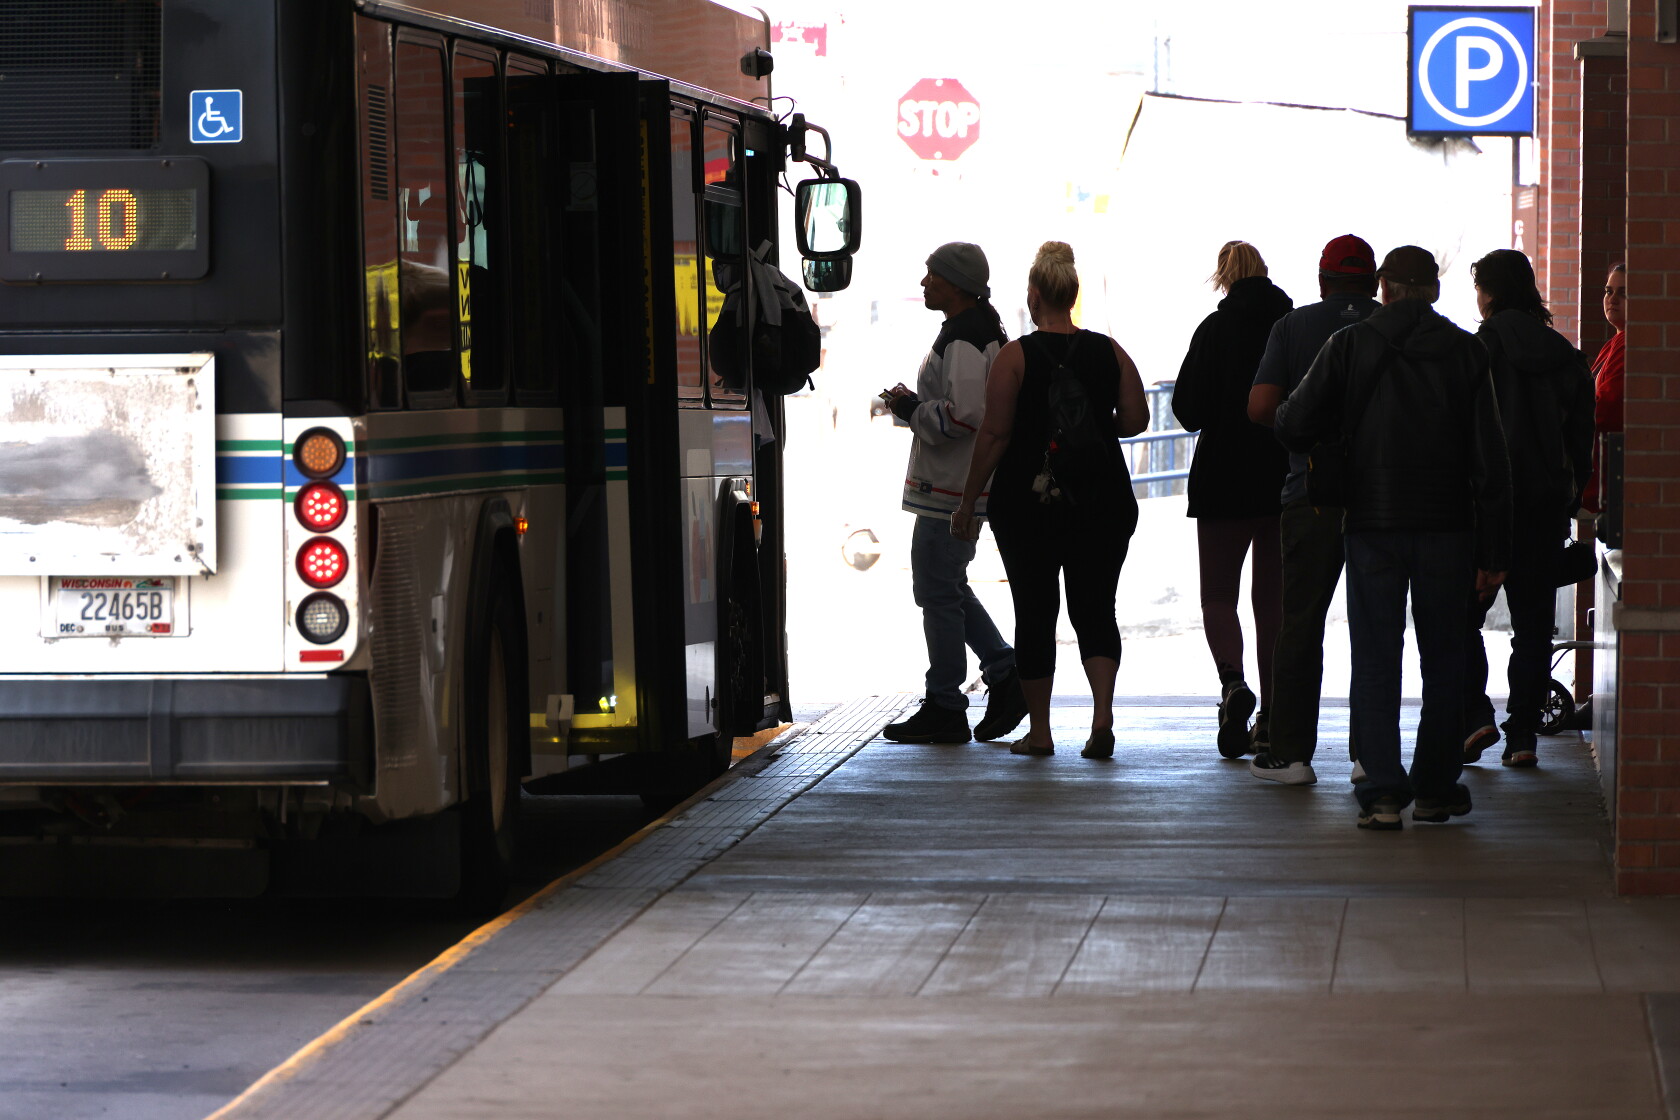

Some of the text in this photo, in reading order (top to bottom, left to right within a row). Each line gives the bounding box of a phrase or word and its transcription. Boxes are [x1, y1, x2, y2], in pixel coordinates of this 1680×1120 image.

[1455, 36, 1503, 109] P
[898, 99, 980, 138] STOP
[65, 189, 137, 250] 10
[61, 578, 123, 588] WISCONSIN
[81, 591, 162, 620] 22465B
[60, 623, 76, 633] DEC
[105, 624, 124, 632] BUS
